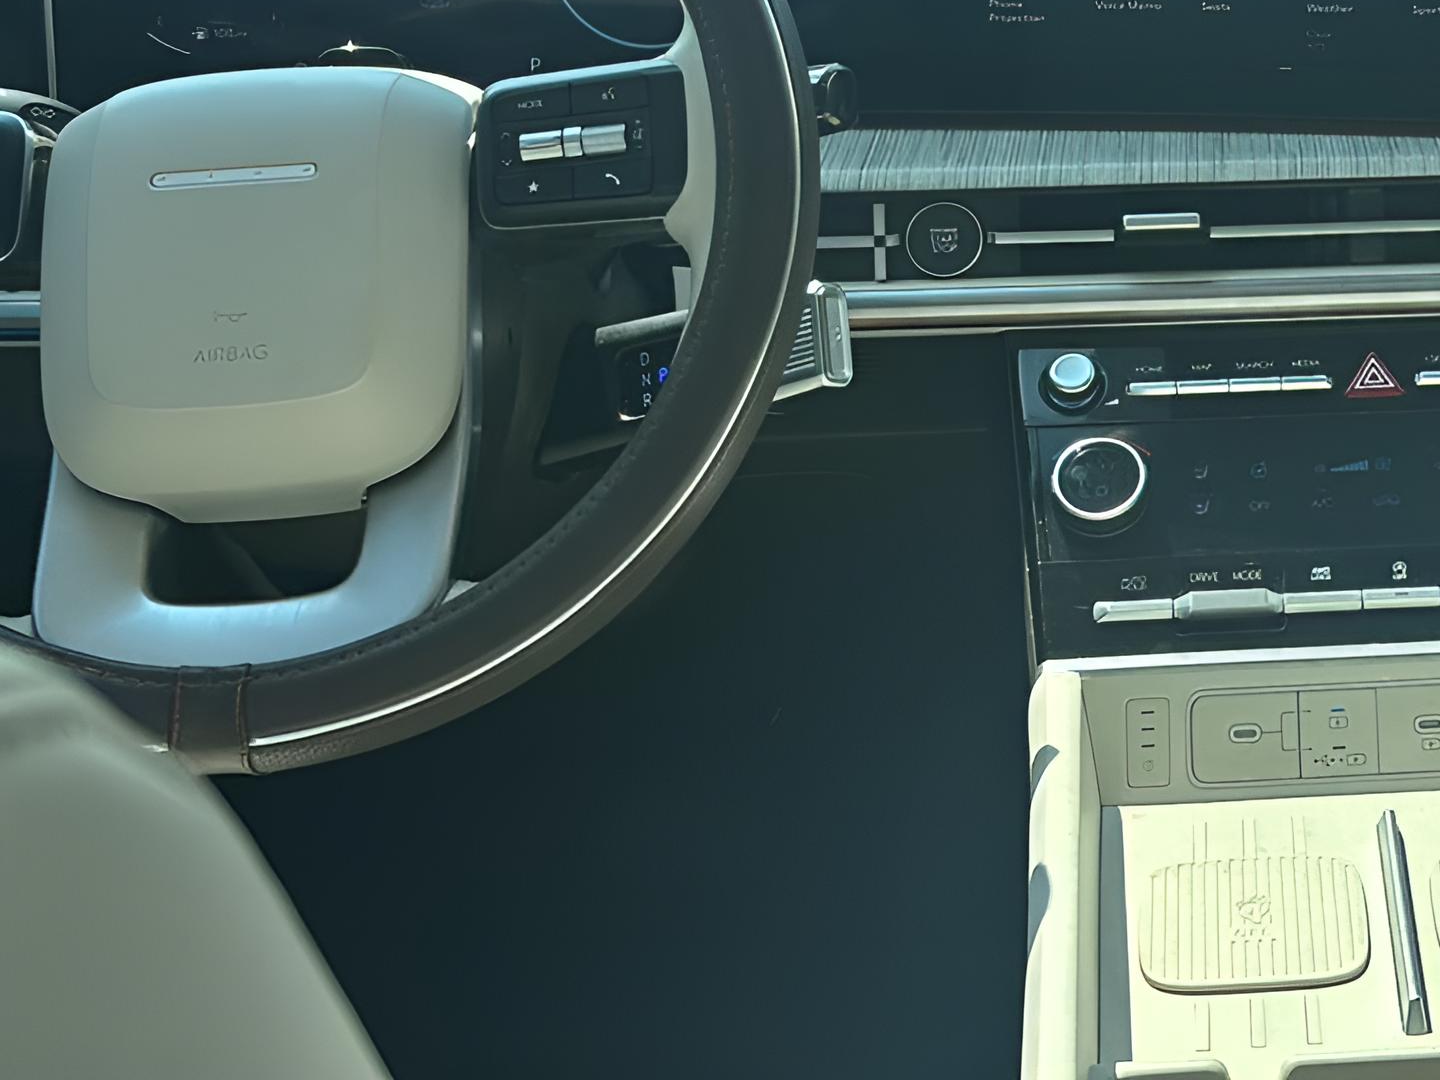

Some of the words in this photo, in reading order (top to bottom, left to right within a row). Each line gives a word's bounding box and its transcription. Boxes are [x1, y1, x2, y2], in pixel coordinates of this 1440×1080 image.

[1305, 2, 1355, 14] Weather
[529, 56, 542, 72] P
[192, 343, 269, 364] AIRBAG
[639, 352, 649, 366] D
[658, 367, 668, 383] P
[1188, 570, 1219, 584] DRIVE
[1232, 568, 1263, 581] MODE
